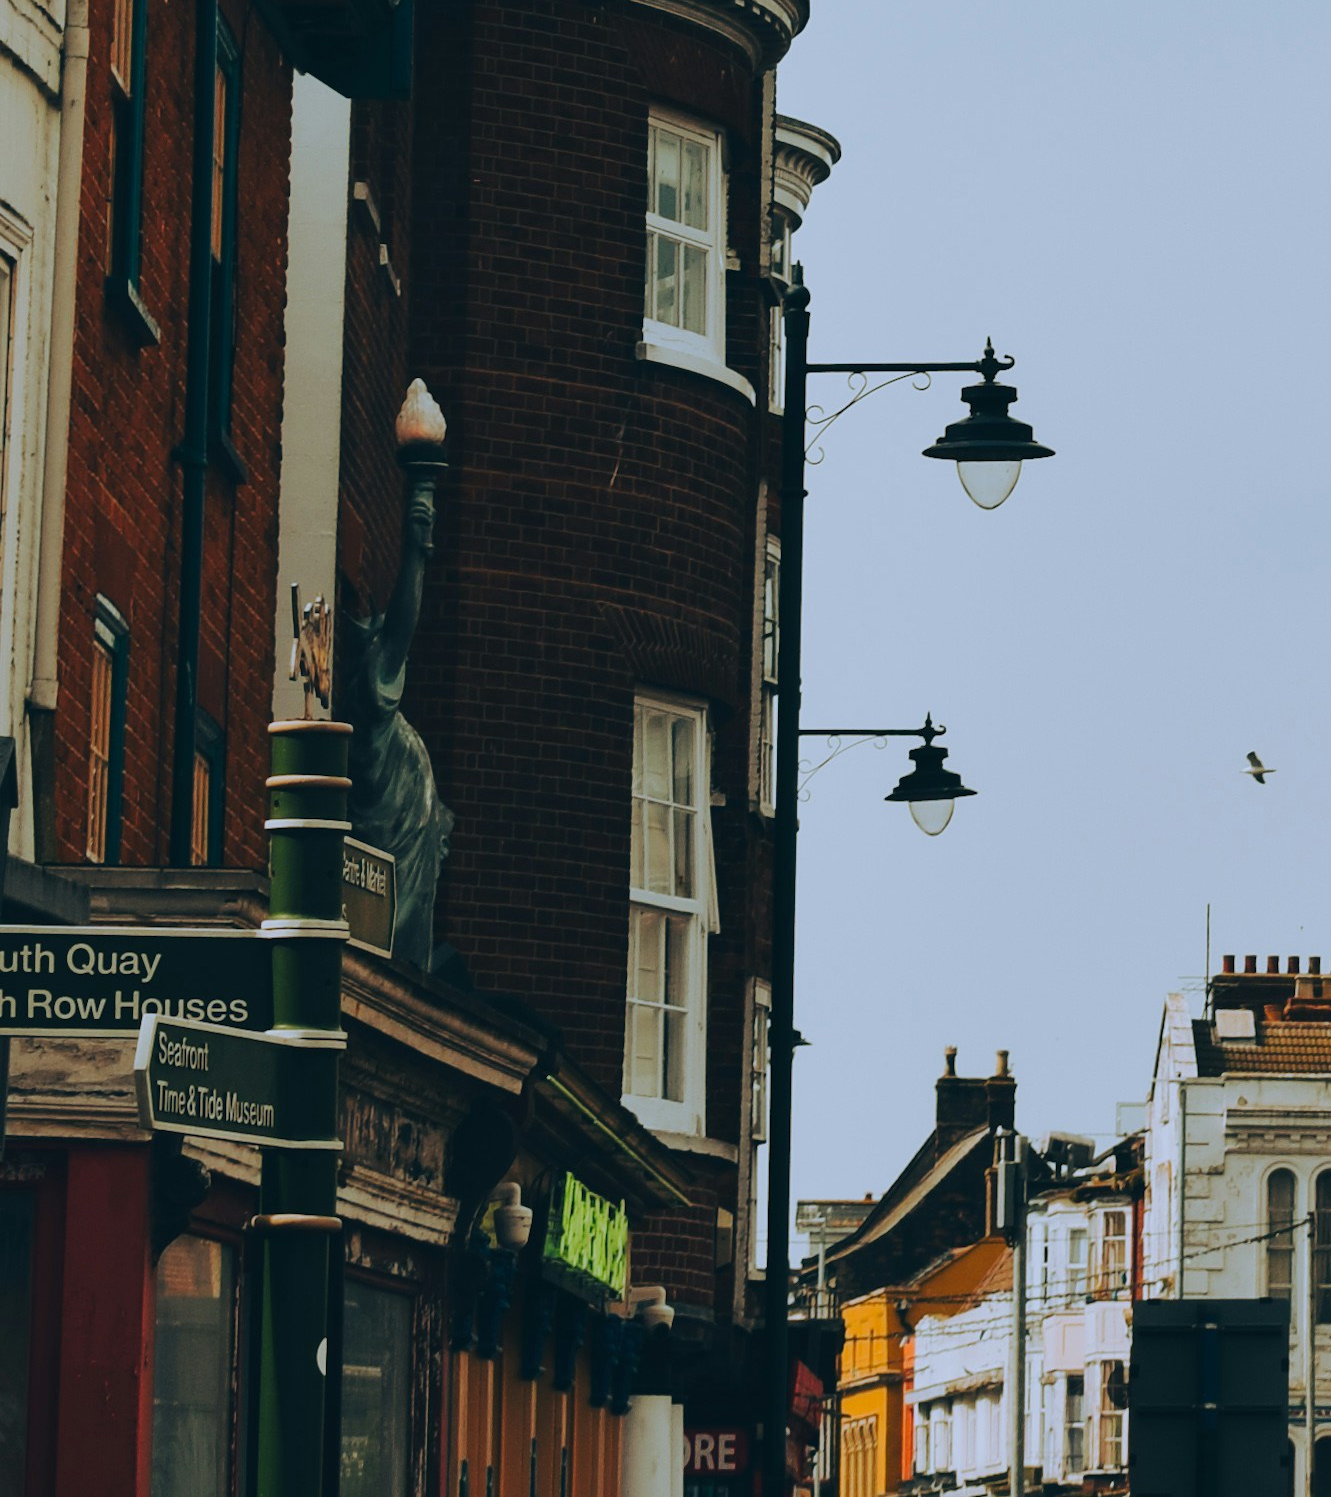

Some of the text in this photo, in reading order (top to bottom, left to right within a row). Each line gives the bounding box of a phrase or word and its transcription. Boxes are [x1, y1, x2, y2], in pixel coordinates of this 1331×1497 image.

[67, 943, 162, 983] Quay
[28, 989, 107, 1021] Row
[115, 990, 249, 1023] Houses
[158, 1031, 209, 1072] Seafront
[156, 1079, 275, 1129] Time & Tide Museum
